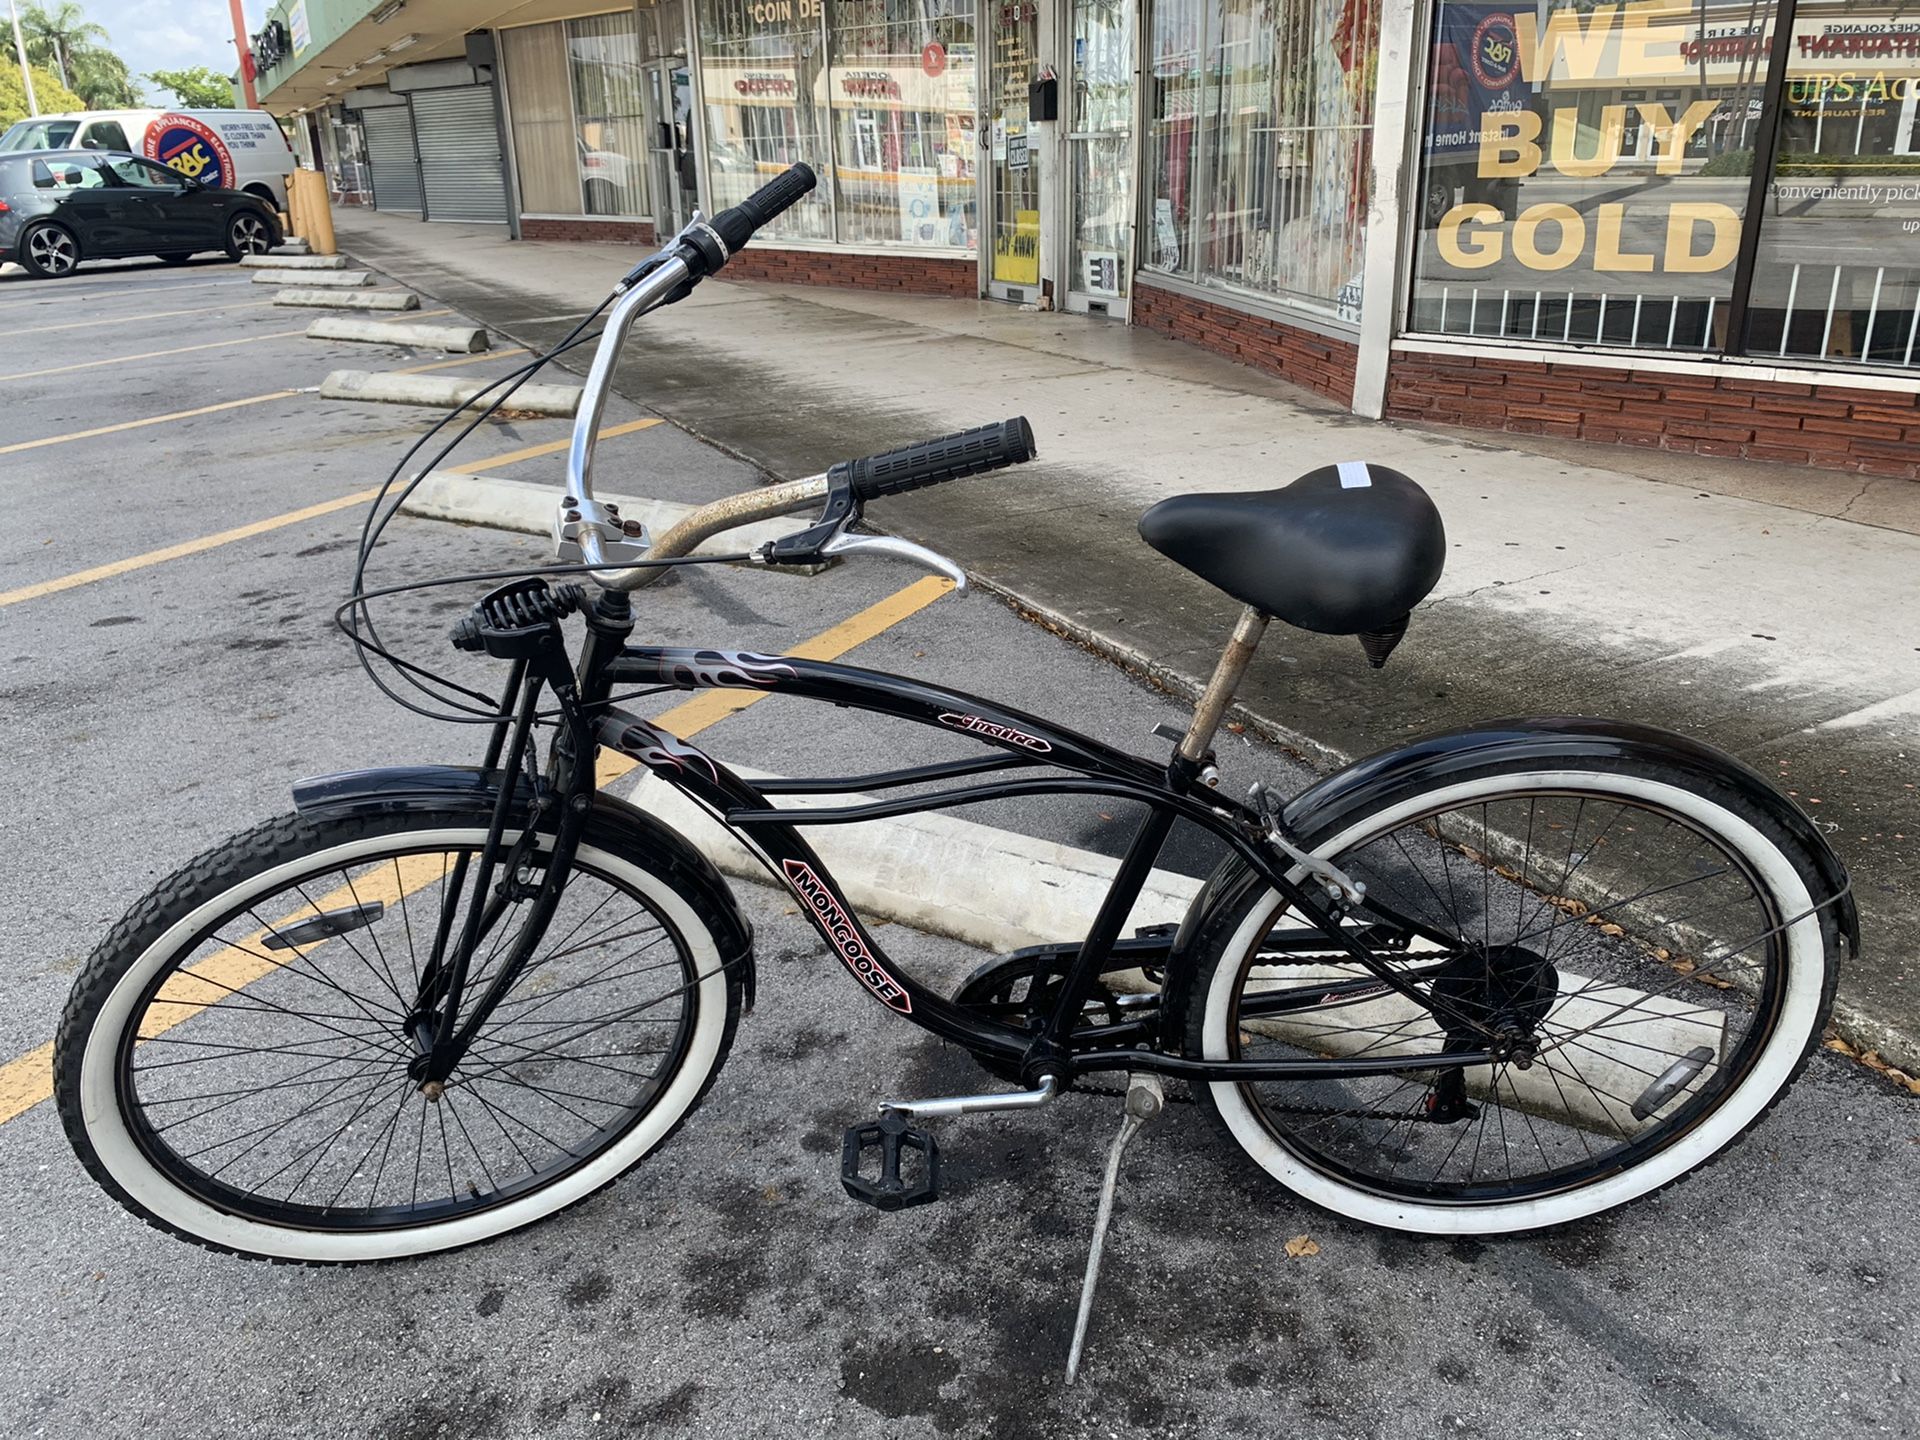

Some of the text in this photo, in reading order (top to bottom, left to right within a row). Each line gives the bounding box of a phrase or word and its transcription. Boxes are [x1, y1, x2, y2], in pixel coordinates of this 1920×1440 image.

[1514, 0, 1692, 82] WE
[1788, 71, 1856, 104] UPS
[154, 117, 202, 134] APPLIANCES
[1476, 99, 1722, 179] BUY
[166, 143, 211, 178] RAC
[210, 136, 232, 191] ELECTRONIC
[1436, 202, 1743, 274] GOLD
[955, 714, 1036, 748] Justice
[793, 867, 902, 1001] MONGOOSE
